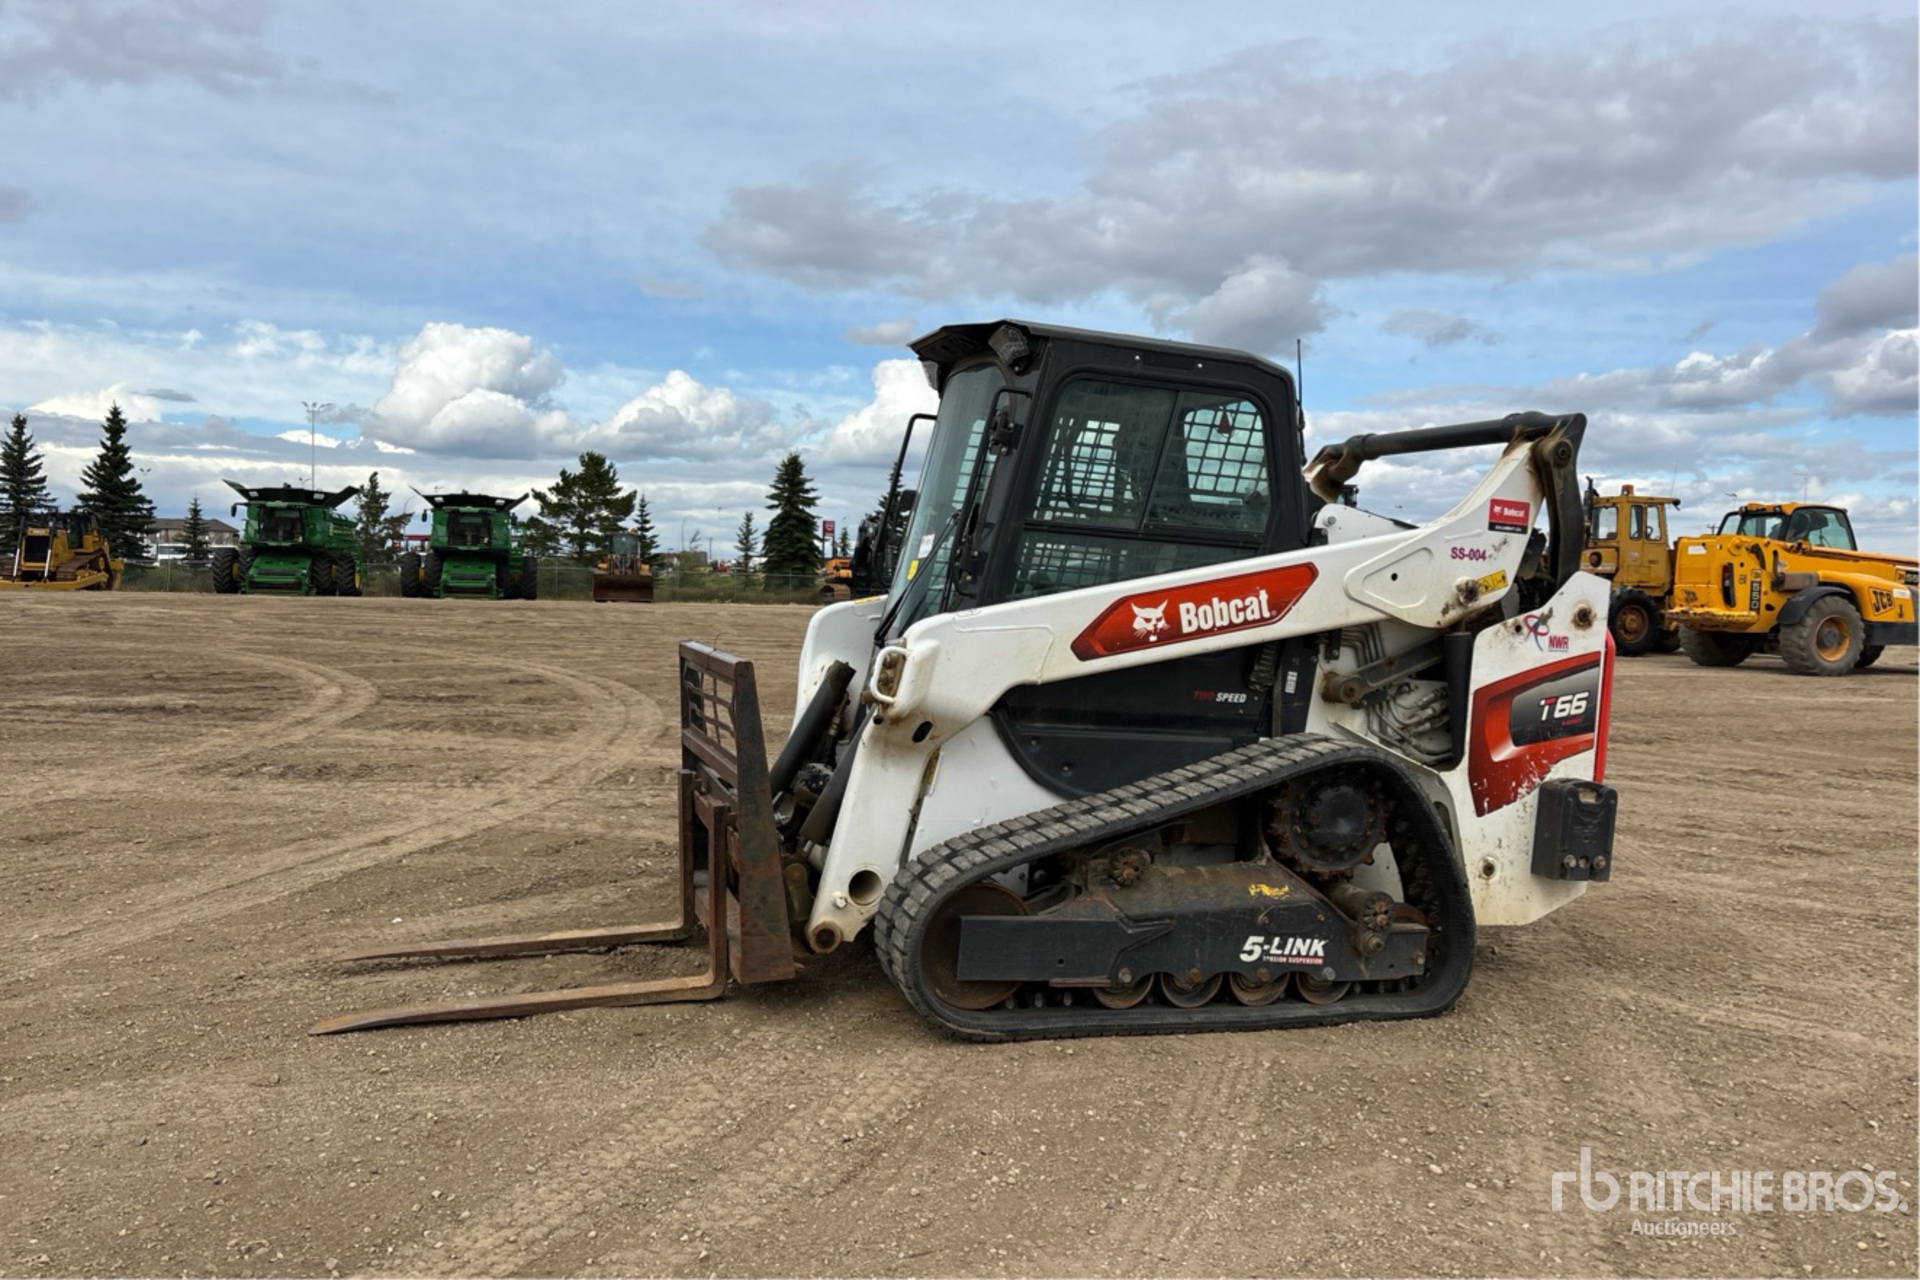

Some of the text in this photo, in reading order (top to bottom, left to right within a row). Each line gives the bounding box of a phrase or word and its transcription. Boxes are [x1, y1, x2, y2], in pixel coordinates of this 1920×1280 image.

[1450, 546, 1487, 562] SS-004
[1179, 590, 1270, 633] Bobcat
[1871, 589, 1894, 613] JCB
[1548, 635, 1569, 650] NWR
[1215, 691, 1247, 703] SPEED
[1539, 691, 1590, 722] T66
[1239, 935, 1328, 962] 5-LINK
